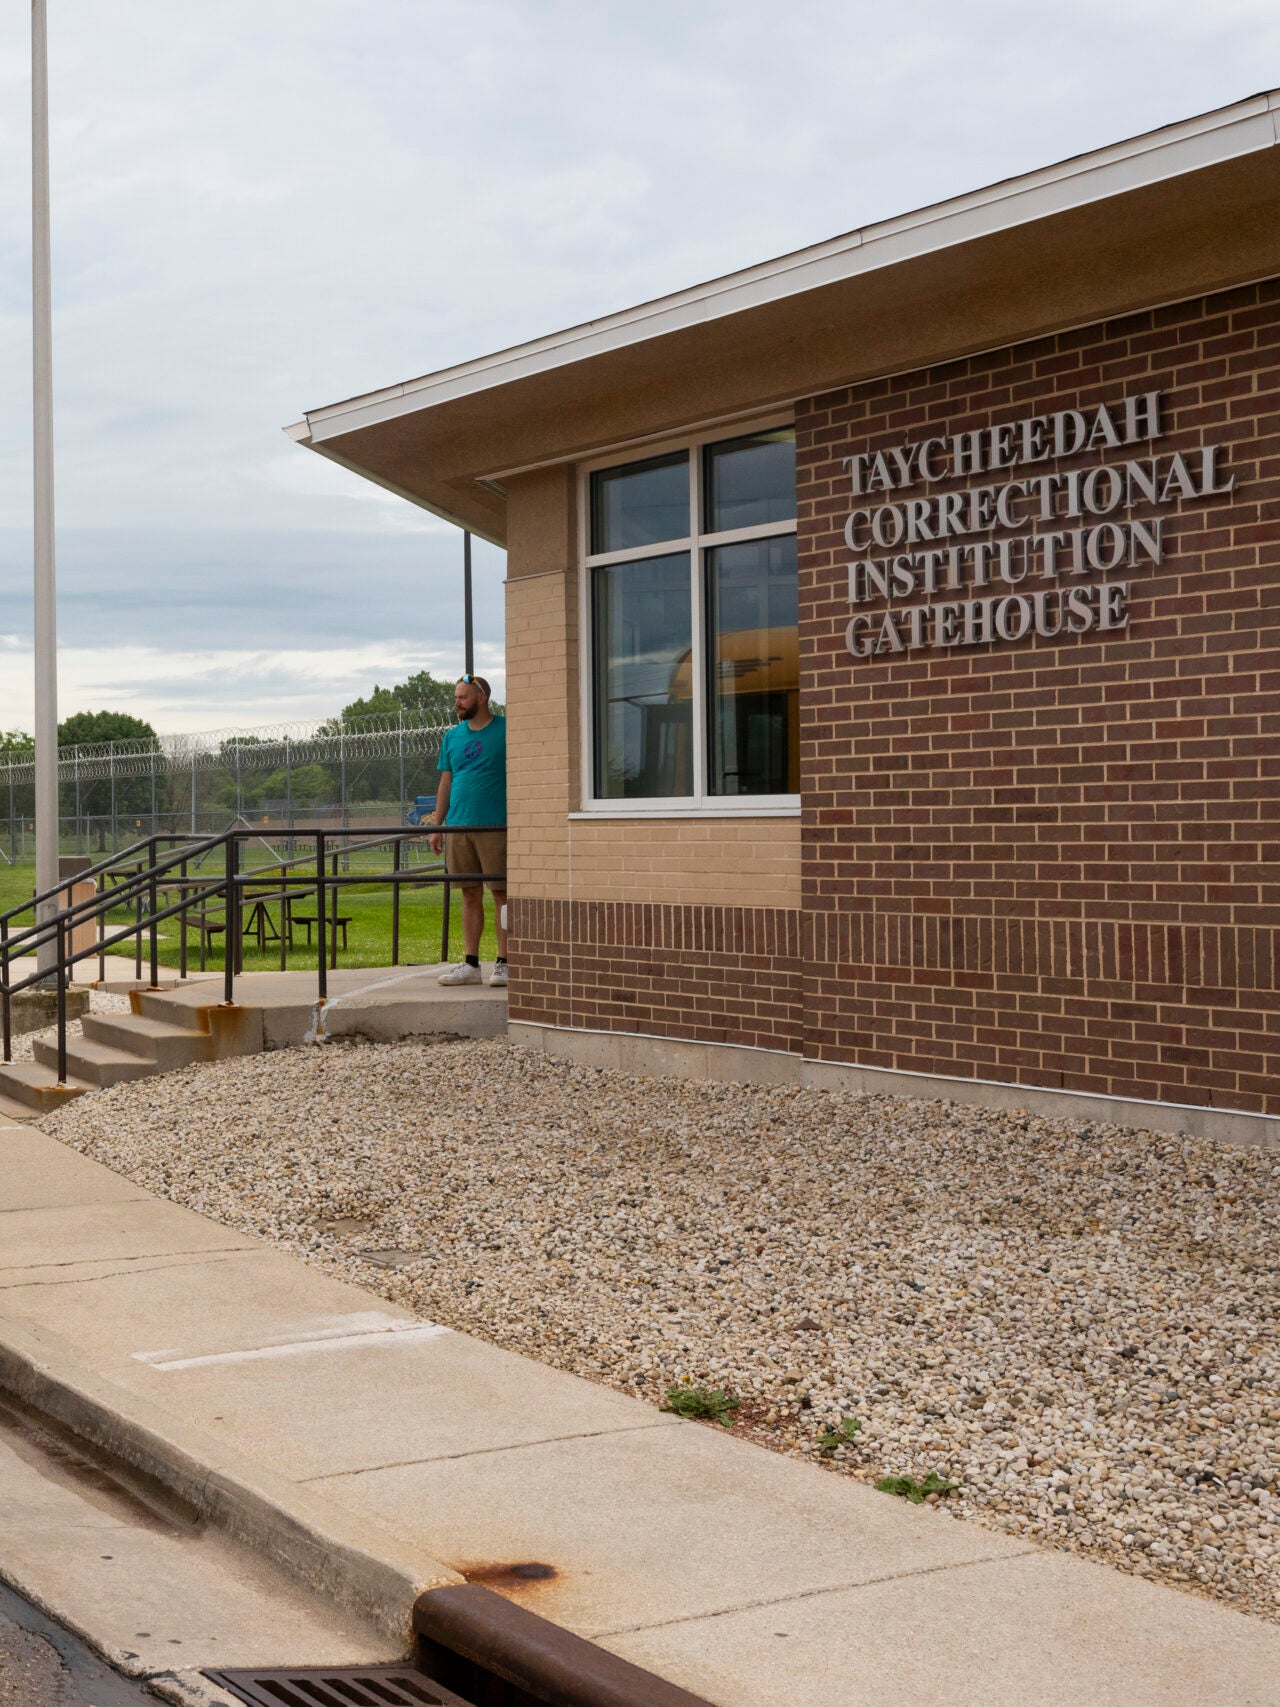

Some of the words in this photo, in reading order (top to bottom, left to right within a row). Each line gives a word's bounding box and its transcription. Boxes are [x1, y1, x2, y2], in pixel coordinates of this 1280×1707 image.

[843, 391, 1164, 495] TAYCHEEDAH
[844, 445, 1238, 551] CORRECTIONAL
[845, 517, 1165, 603] INSTITUTION
[845, 582, 1130, 657] GATEHOUSE
